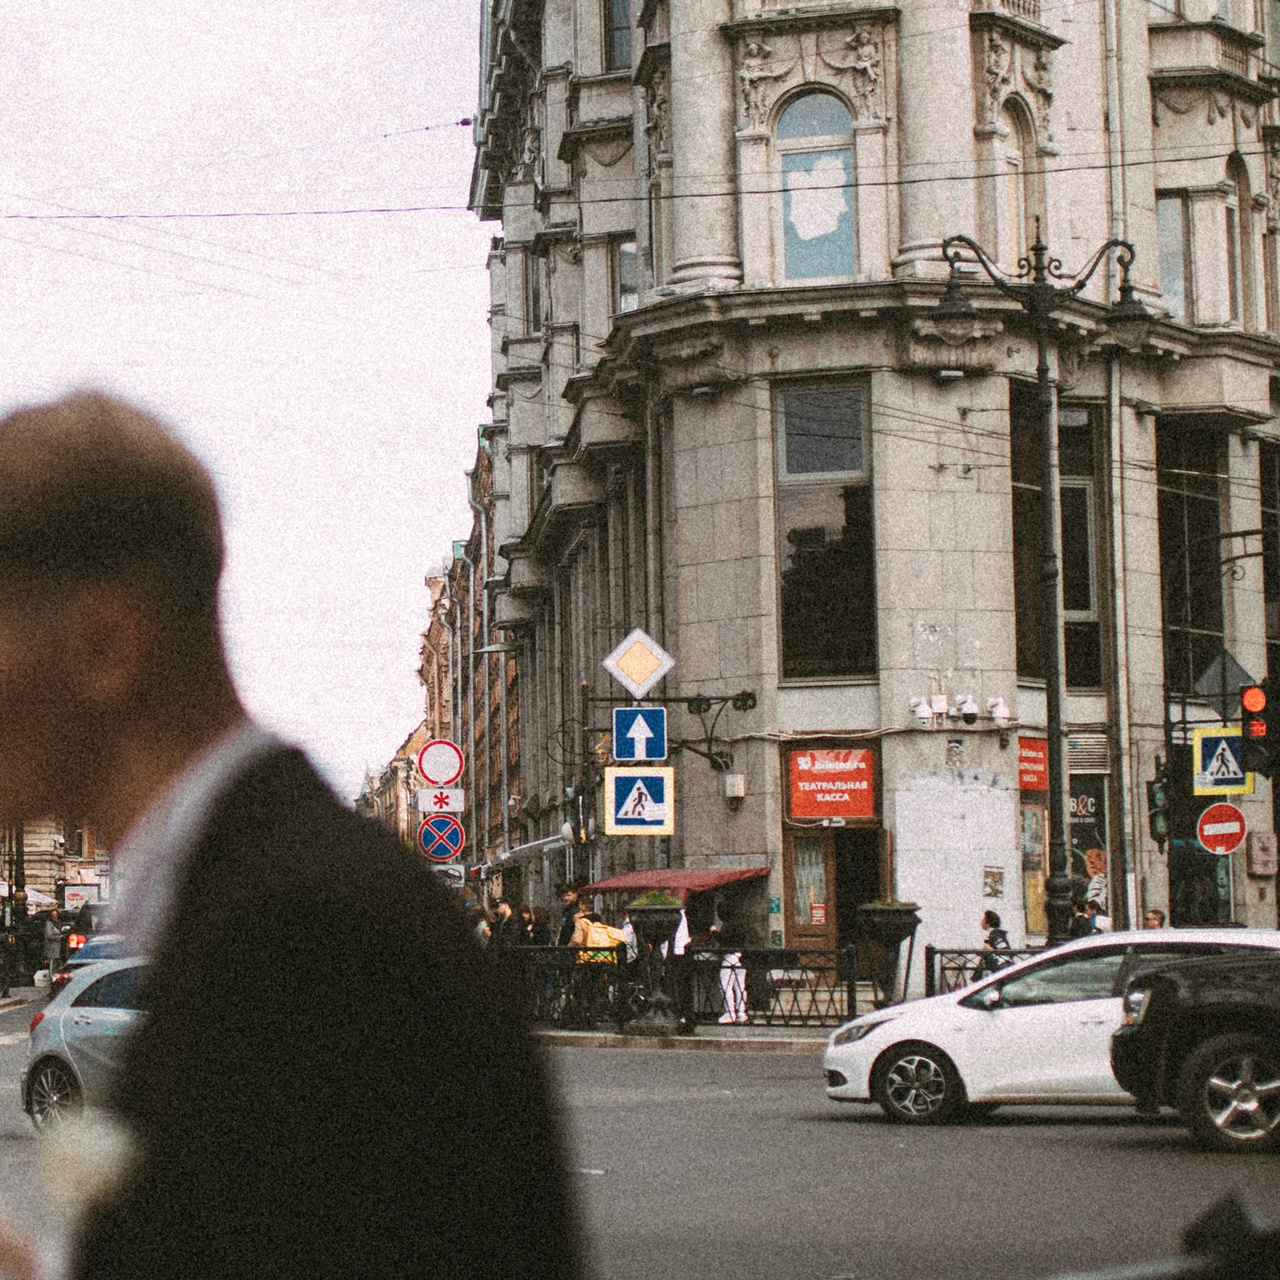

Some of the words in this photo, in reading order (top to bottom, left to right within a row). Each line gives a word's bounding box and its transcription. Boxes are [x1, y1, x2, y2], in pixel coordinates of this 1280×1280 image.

[798, 781, 868, 791] ТЕАТРАЛЬНАЯ
[816, 793, 850, 802] КАССА
[1070, 795, 1096, 816] B&C
